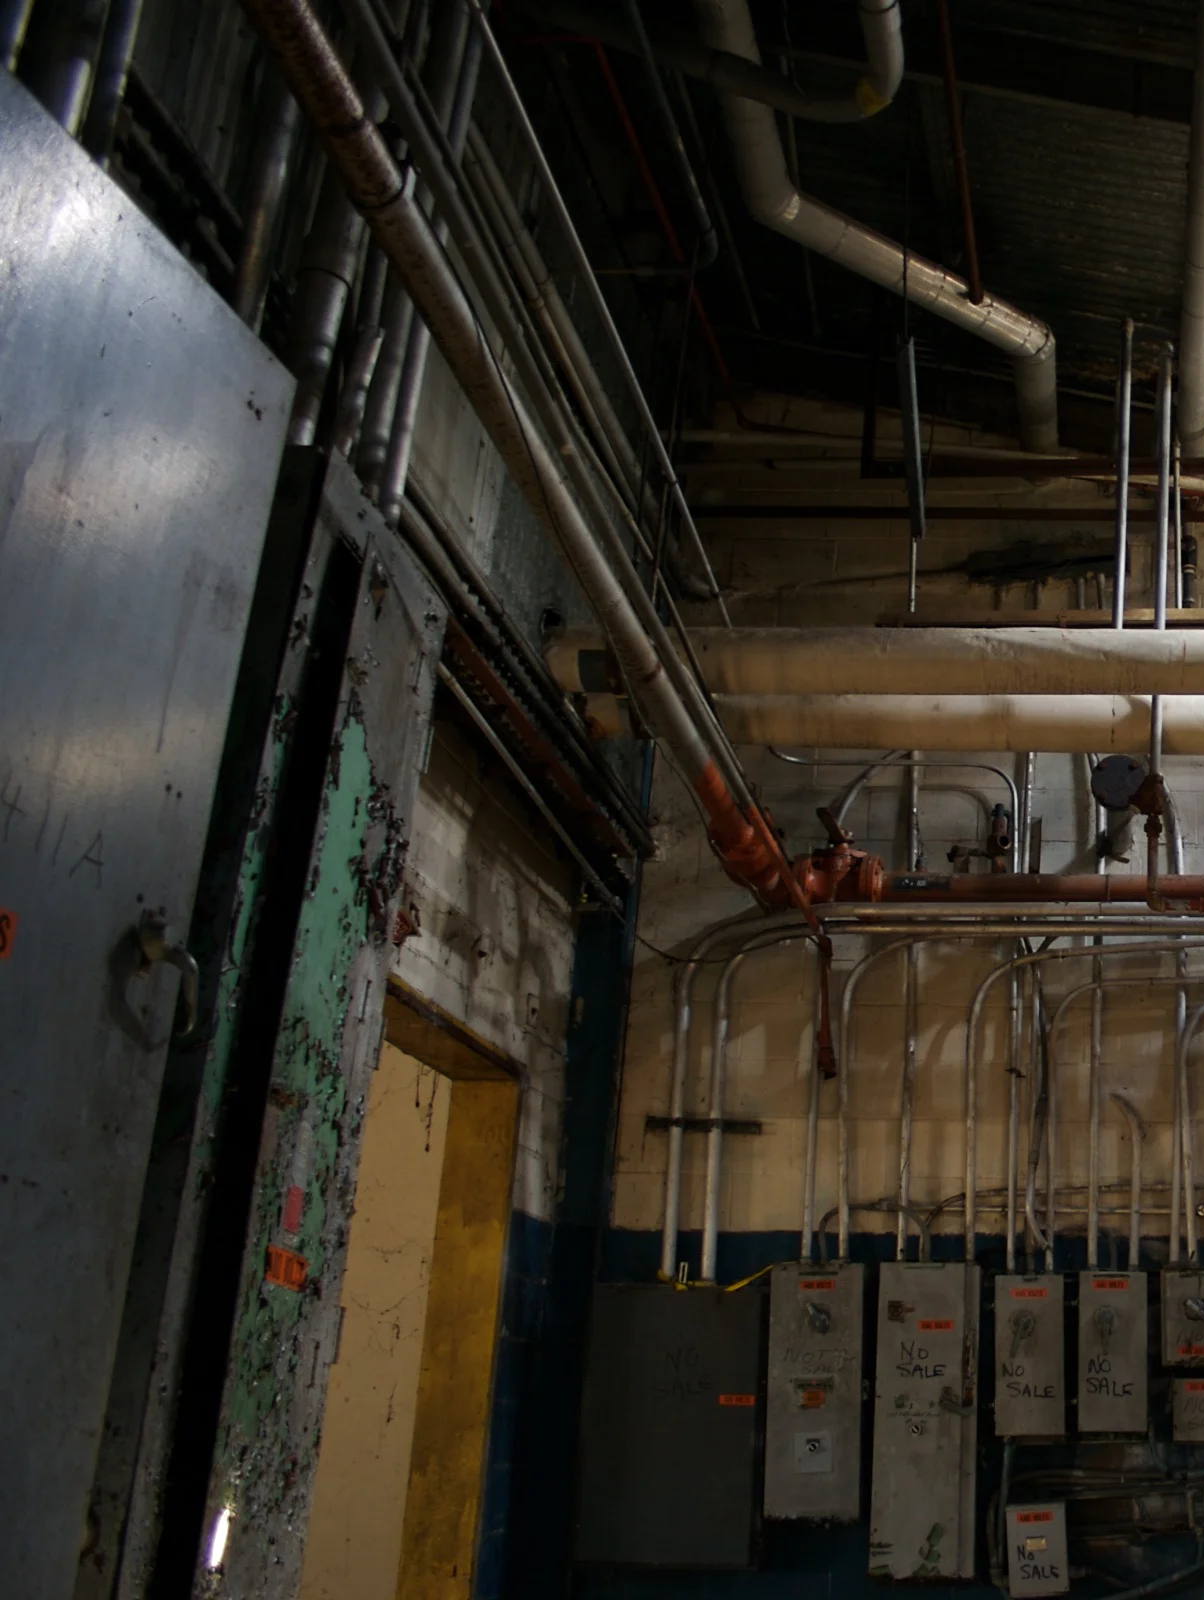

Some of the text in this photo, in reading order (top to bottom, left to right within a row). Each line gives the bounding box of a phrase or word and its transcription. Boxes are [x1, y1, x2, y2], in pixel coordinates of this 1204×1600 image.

[666, 1346, 699, 1372] NO
[896, 1362, 947, 1379] SALE
[652, 1373, 714, 1400] SALE
[1006, 1381, 1057, 1399] SALE
[1086, 1376, 1135, 1397] SALE
[1020, 1564, 1060, 1580] SALE
